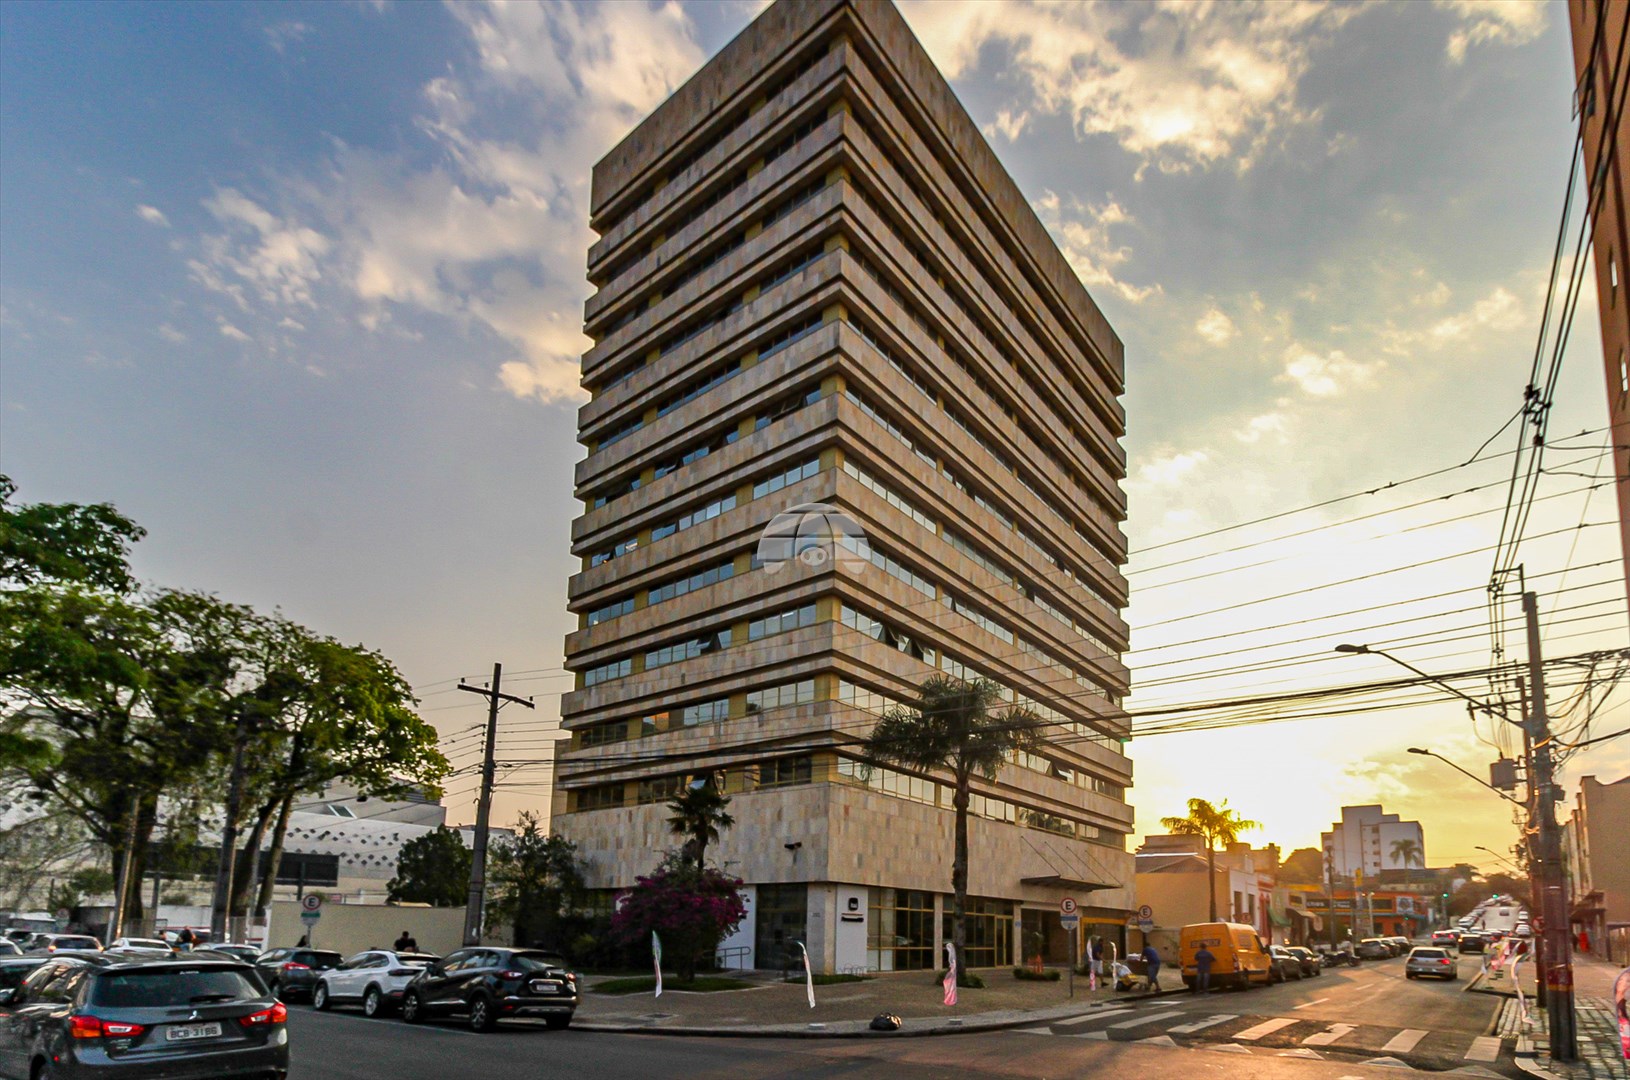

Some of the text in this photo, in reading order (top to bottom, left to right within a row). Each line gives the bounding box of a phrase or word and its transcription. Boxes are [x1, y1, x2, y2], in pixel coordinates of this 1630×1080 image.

[308, 897, 316, 907] E
[1065, 901, 1072, 910] E
[1142, 908, 1148, 916] E
